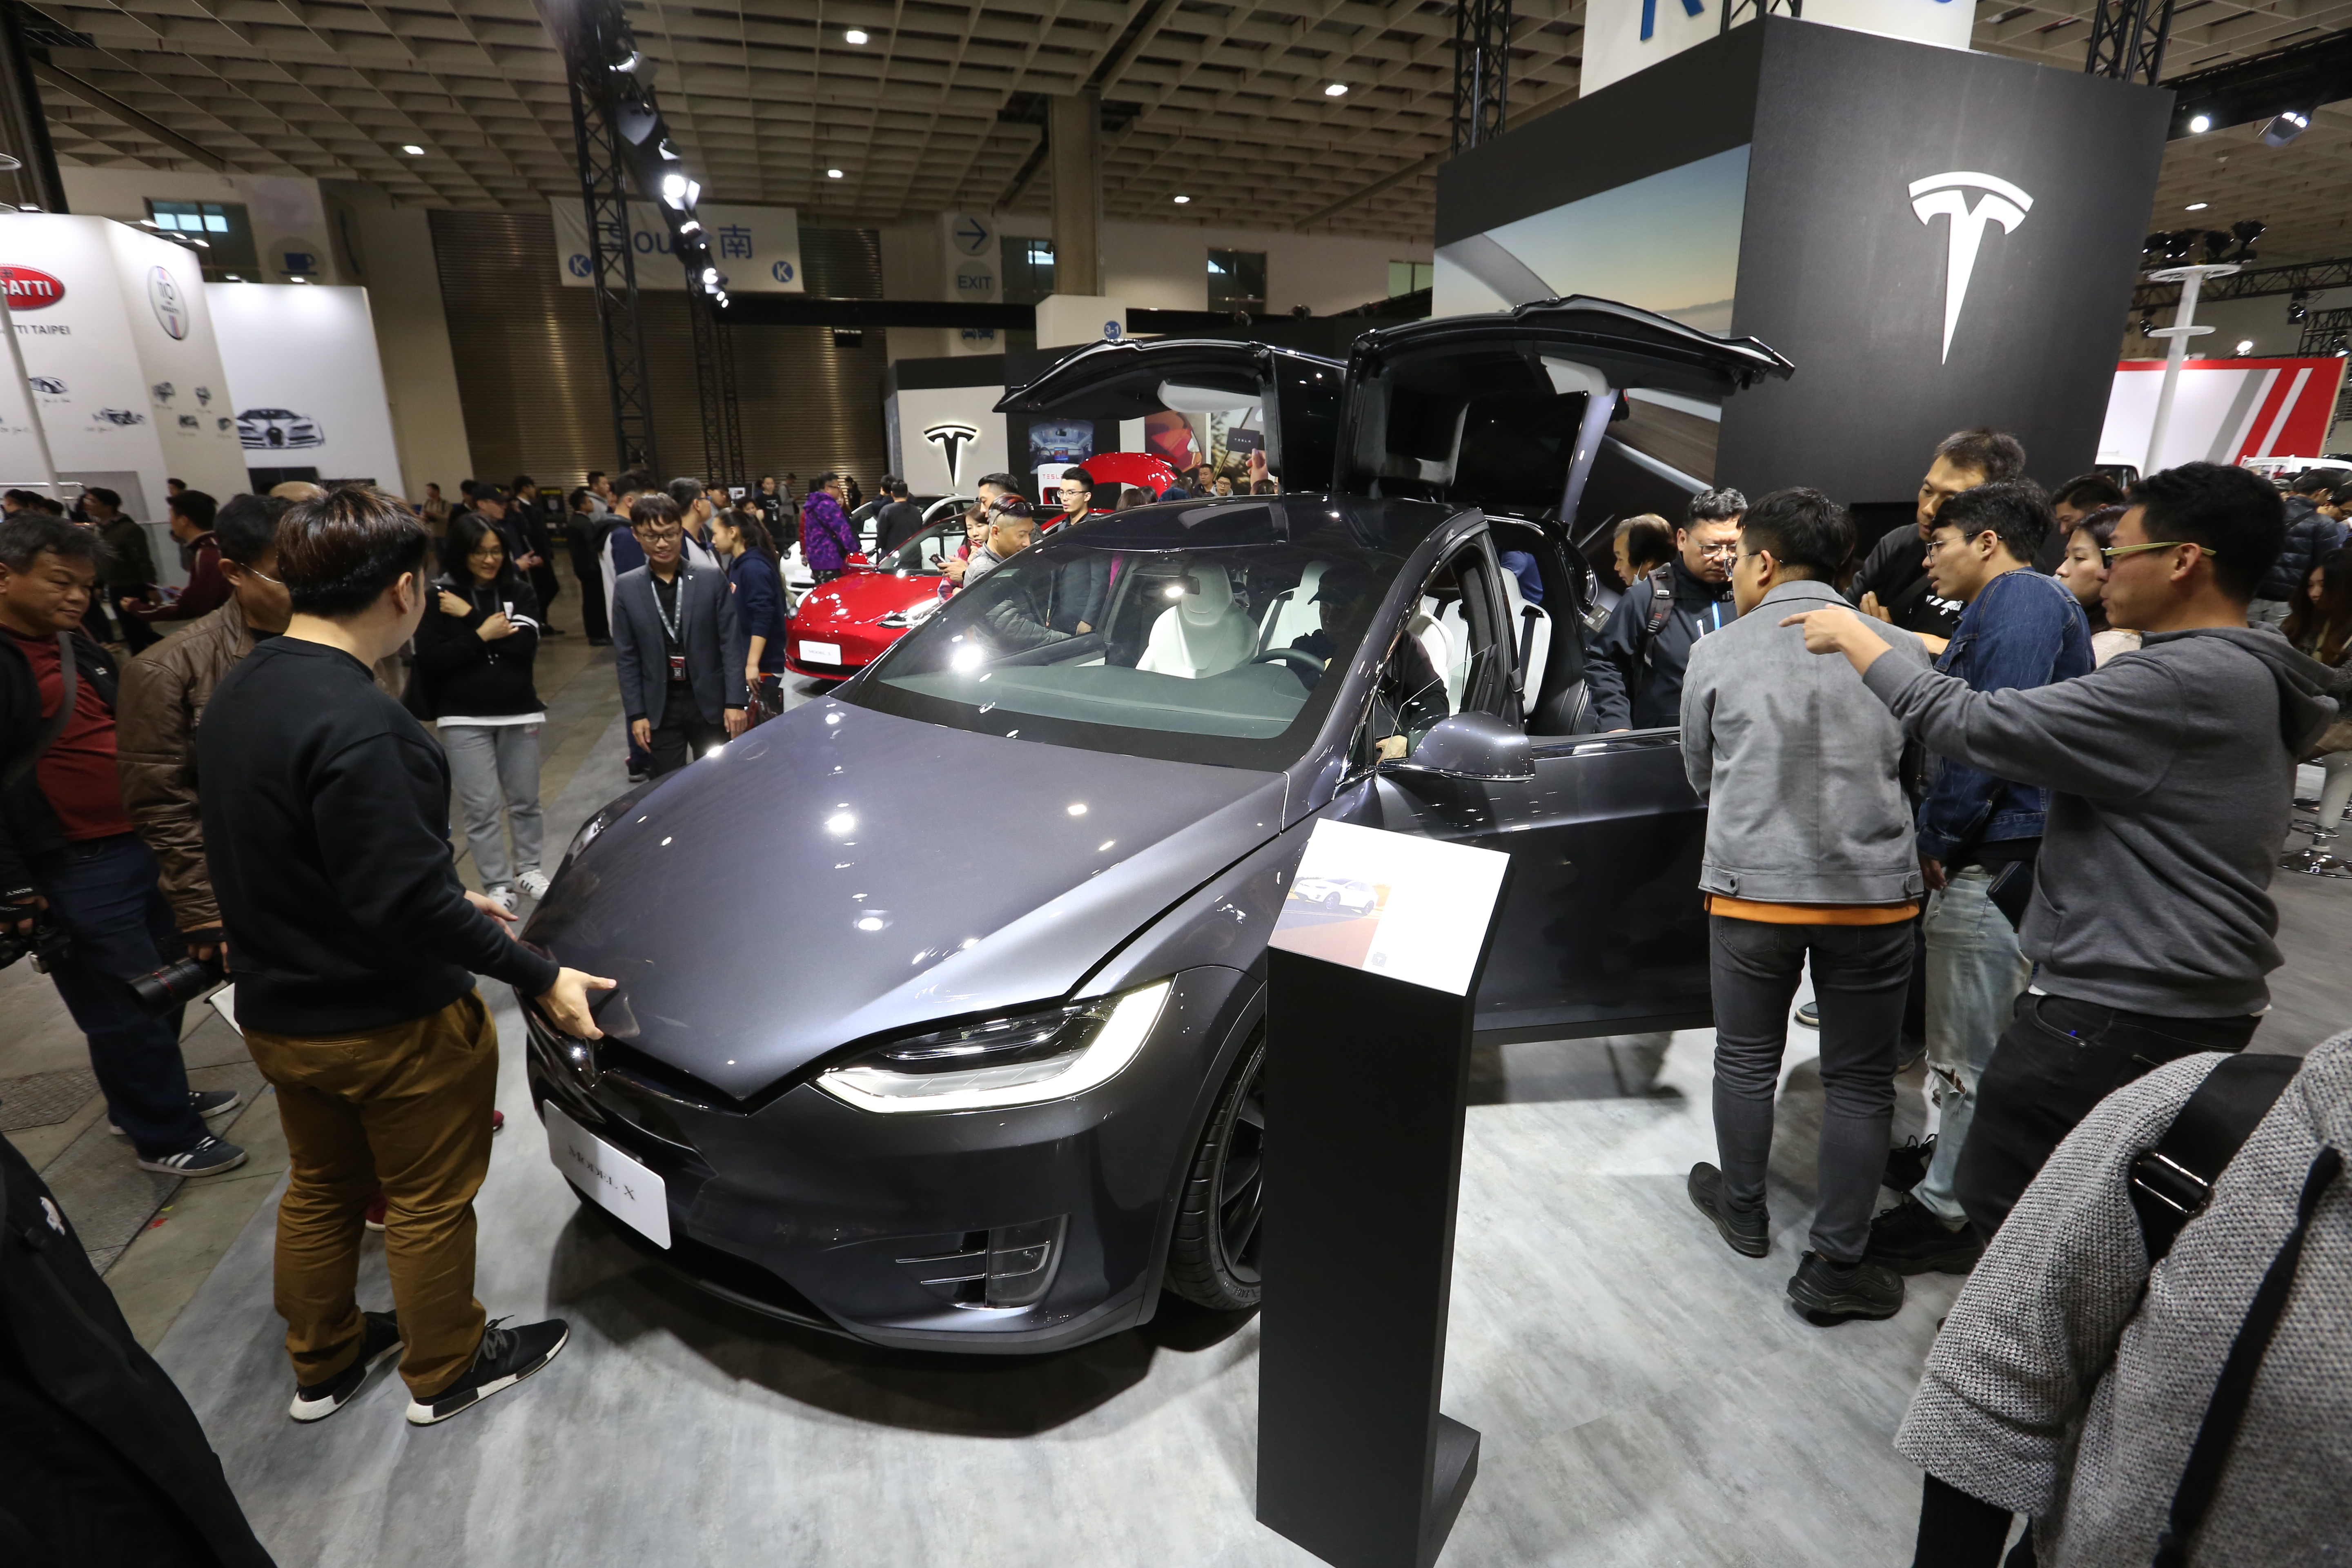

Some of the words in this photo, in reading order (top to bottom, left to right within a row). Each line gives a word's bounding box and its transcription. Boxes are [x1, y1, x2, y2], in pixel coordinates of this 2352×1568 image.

[718, 224, 752, 259] 南
[573, 257, 587, 274] K
[777, 263, 788, 280] K
[958, 275, 992, 289] EXIT
[29, 325, 71, 334] TAIPEI
[1105, 325, 1119, 334] 3-1
[624, 1185, 636, 1201] X
